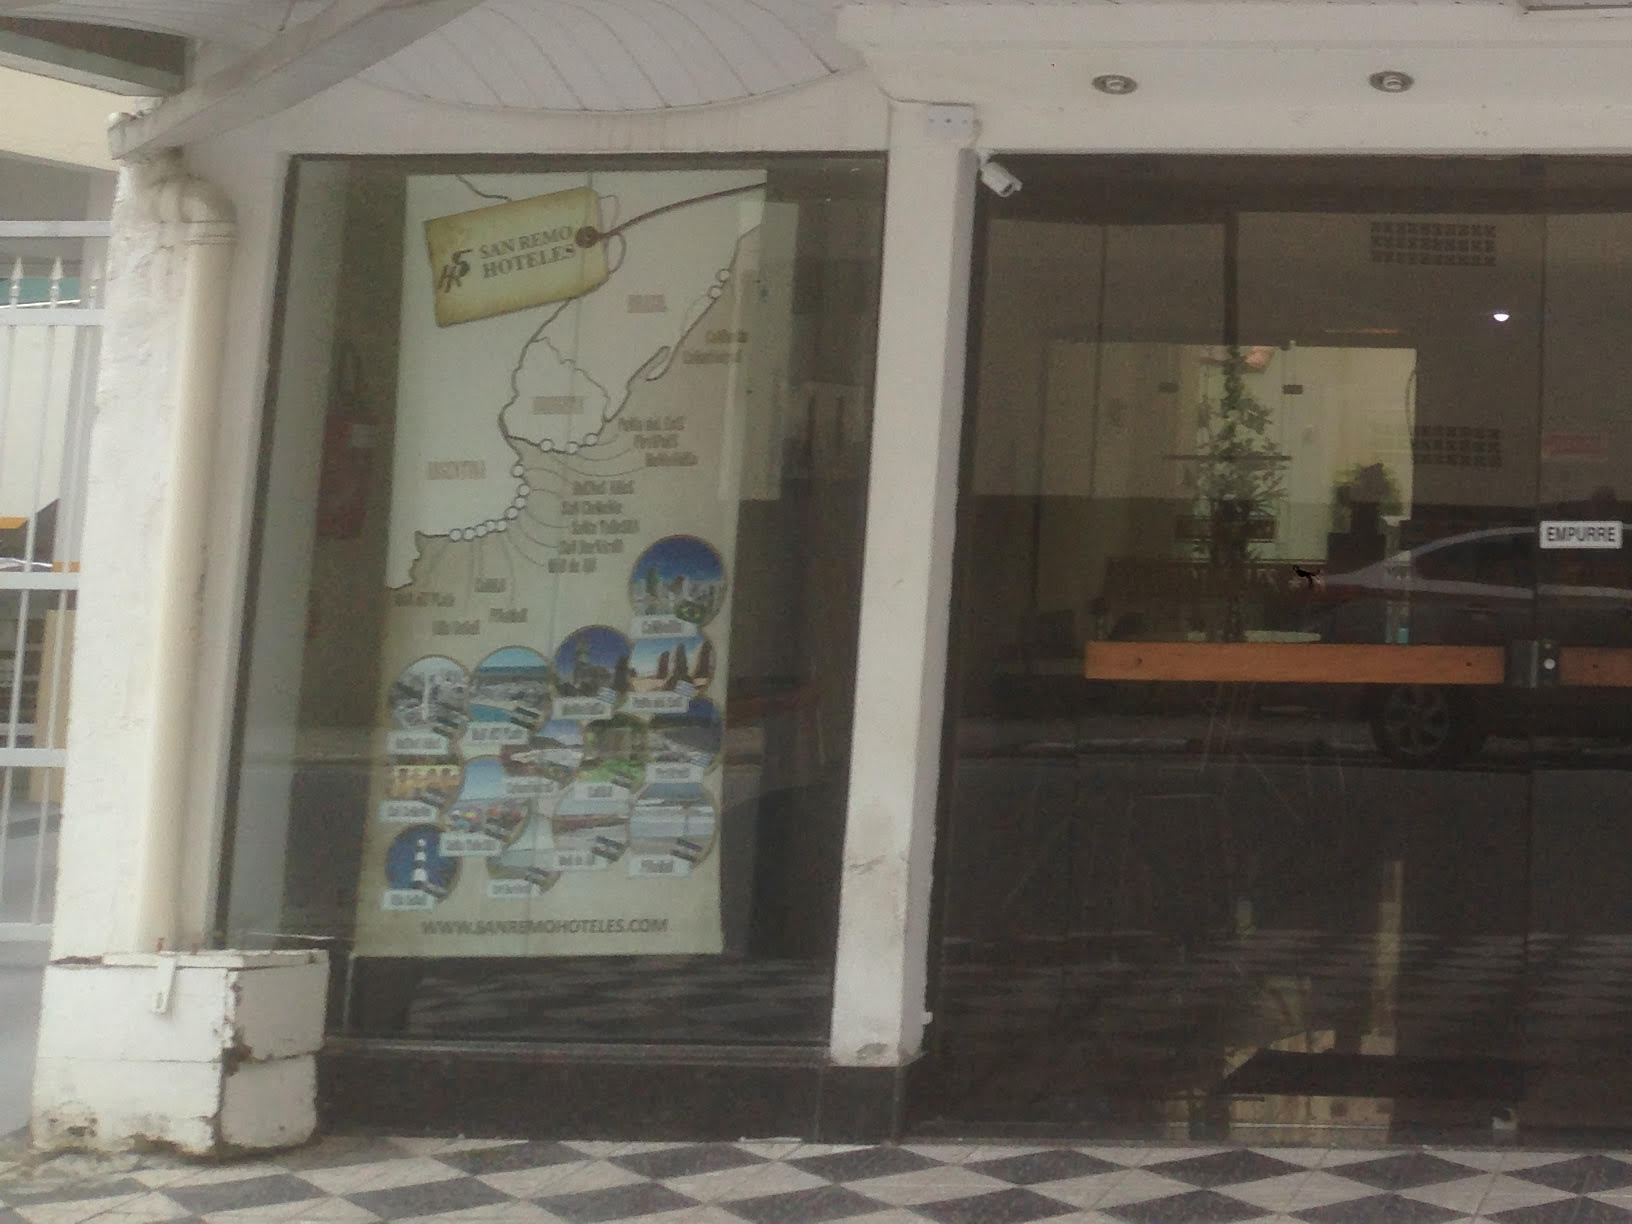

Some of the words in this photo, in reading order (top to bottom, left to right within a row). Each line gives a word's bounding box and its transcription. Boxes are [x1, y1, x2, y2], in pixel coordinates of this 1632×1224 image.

[479, 238, 515, 259] SAN
[519, 226, 573, 249] REMO
[482, 244, 576, 278] HOTELES
[1548, 526, 1616, 542] EMPURRE
[422, 918, 669, 935] WWW.SANREMOHOTELES.COM
